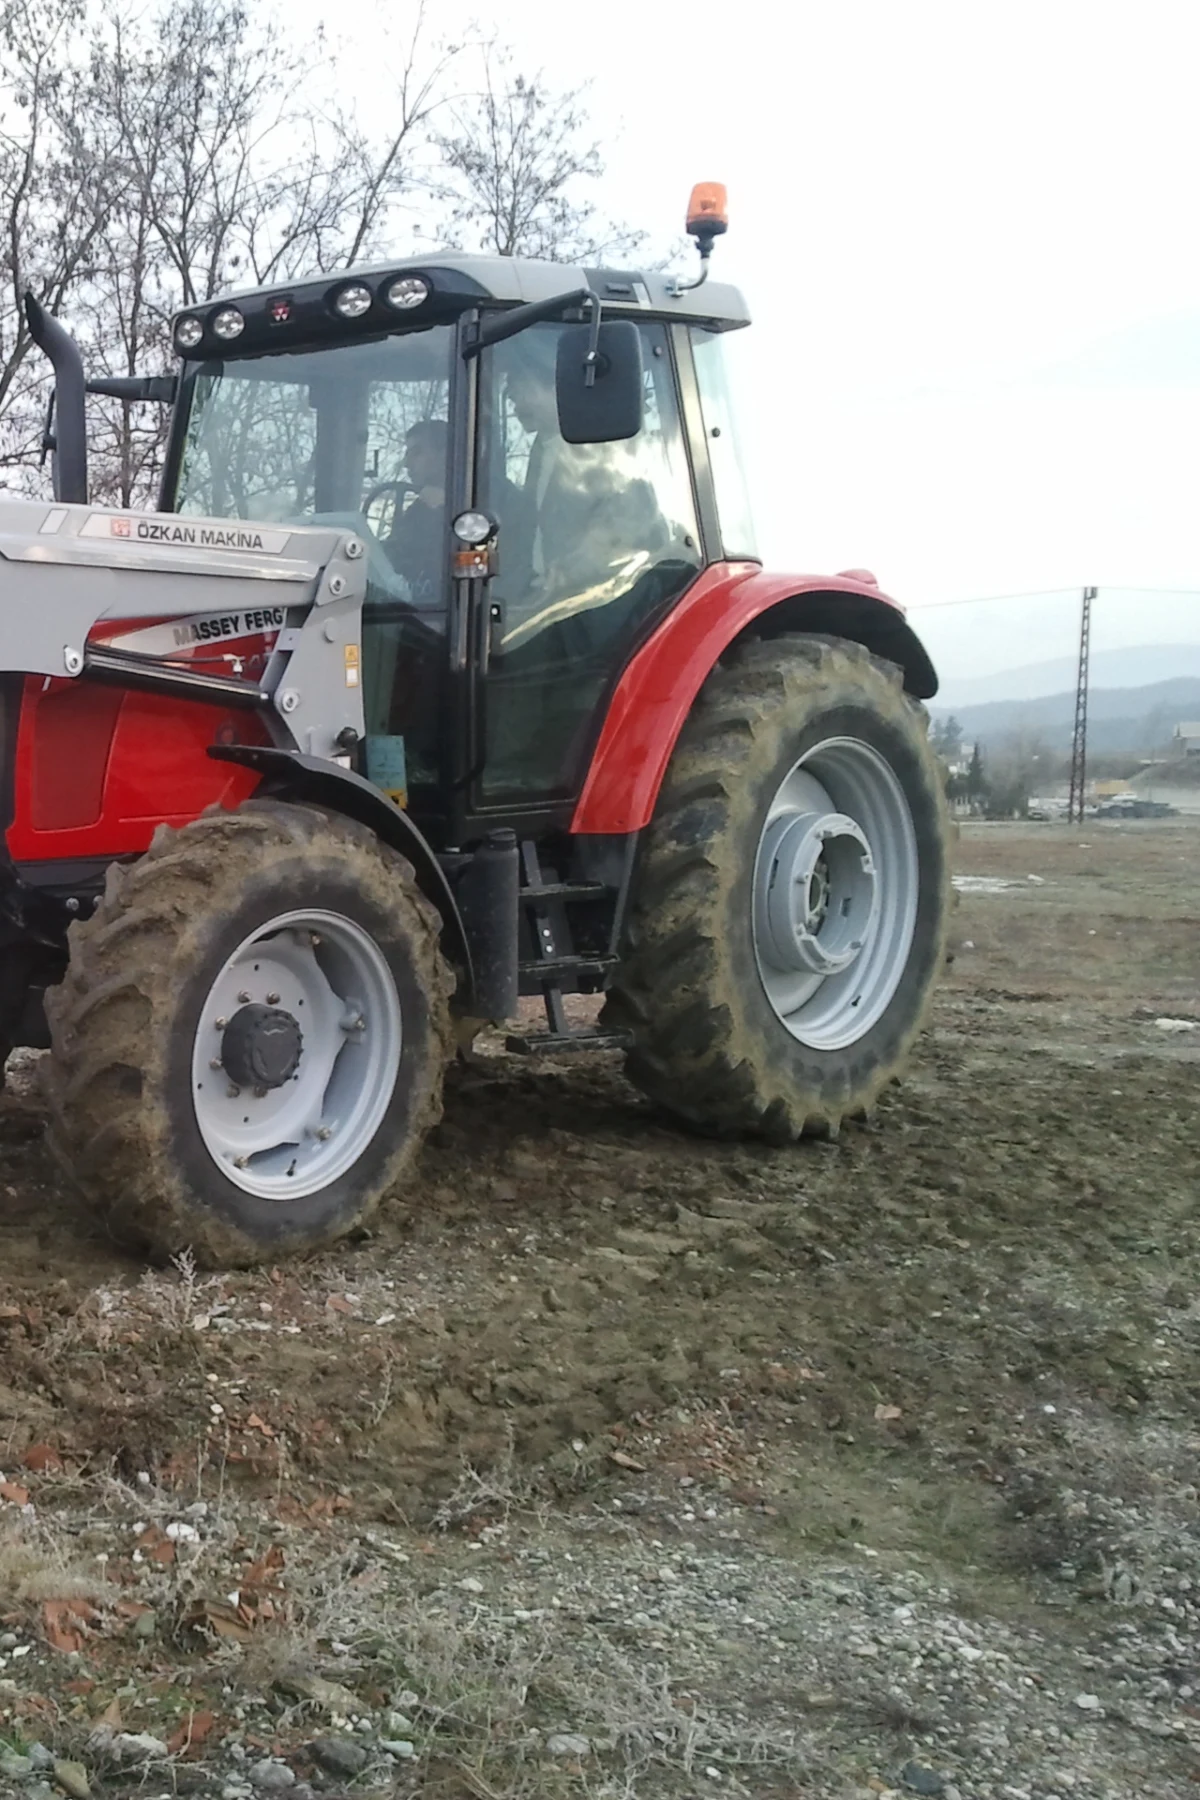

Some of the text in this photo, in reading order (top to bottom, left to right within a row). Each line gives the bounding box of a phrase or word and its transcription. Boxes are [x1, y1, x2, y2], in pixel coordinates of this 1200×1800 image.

[138, 521, 263, 549] ÖZKAN MAKİNA
[173, 608, 283, 646] MASSEY FERG
